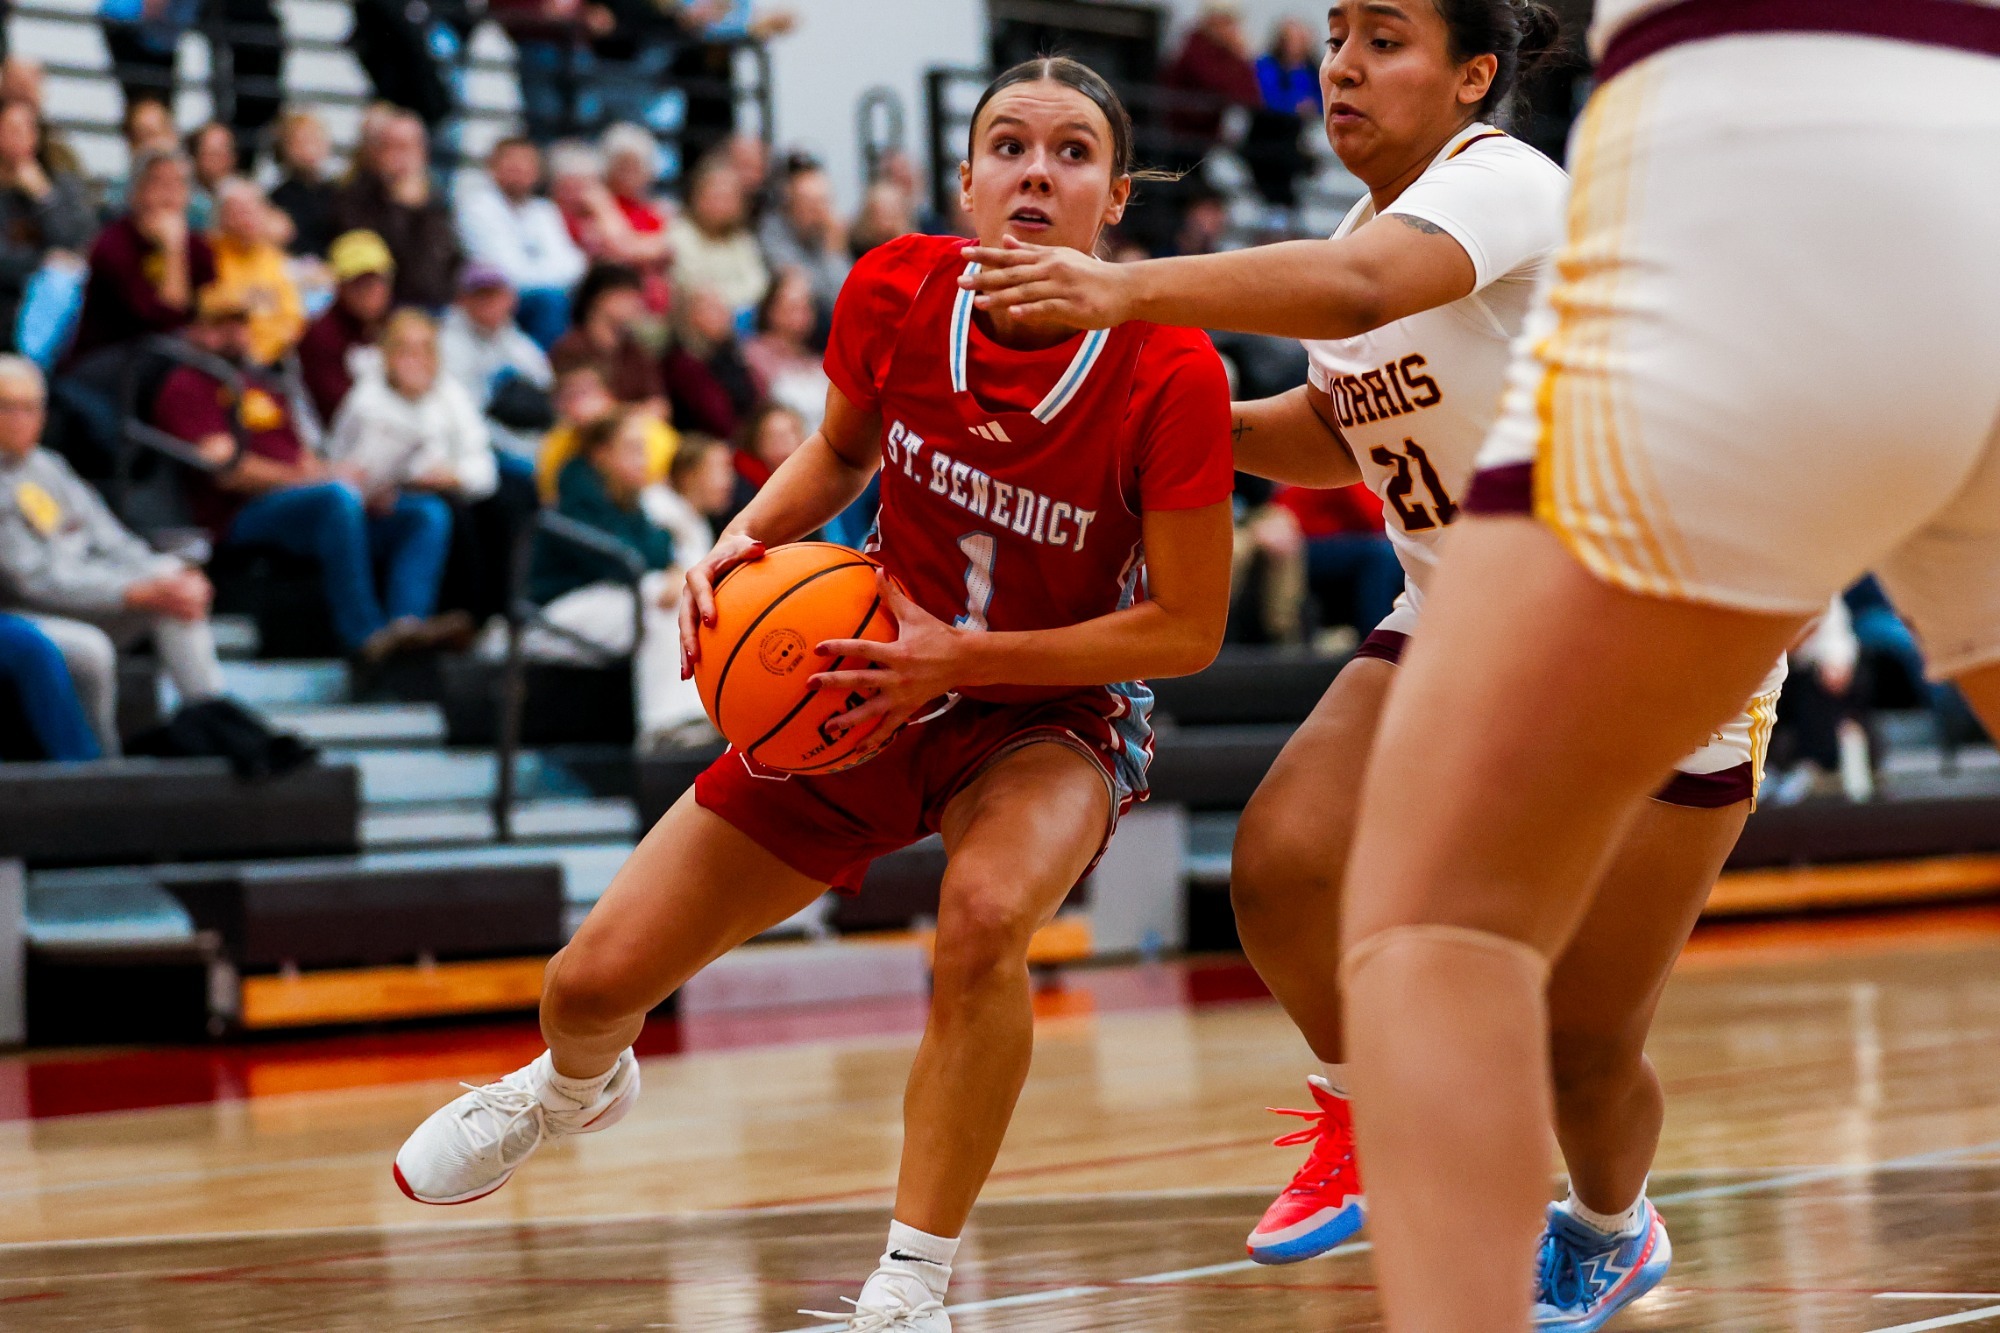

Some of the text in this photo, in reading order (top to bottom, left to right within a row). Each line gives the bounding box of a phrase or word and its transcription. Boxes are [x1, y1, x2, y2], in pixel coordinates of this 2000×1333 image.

[1330, 352, 1443, 428] ORRIS
[887, 419, 1097, 553] ST. BENEDICT
[1369, 436, 1460, 532] 21
[953, 530, 997, 632] 1
